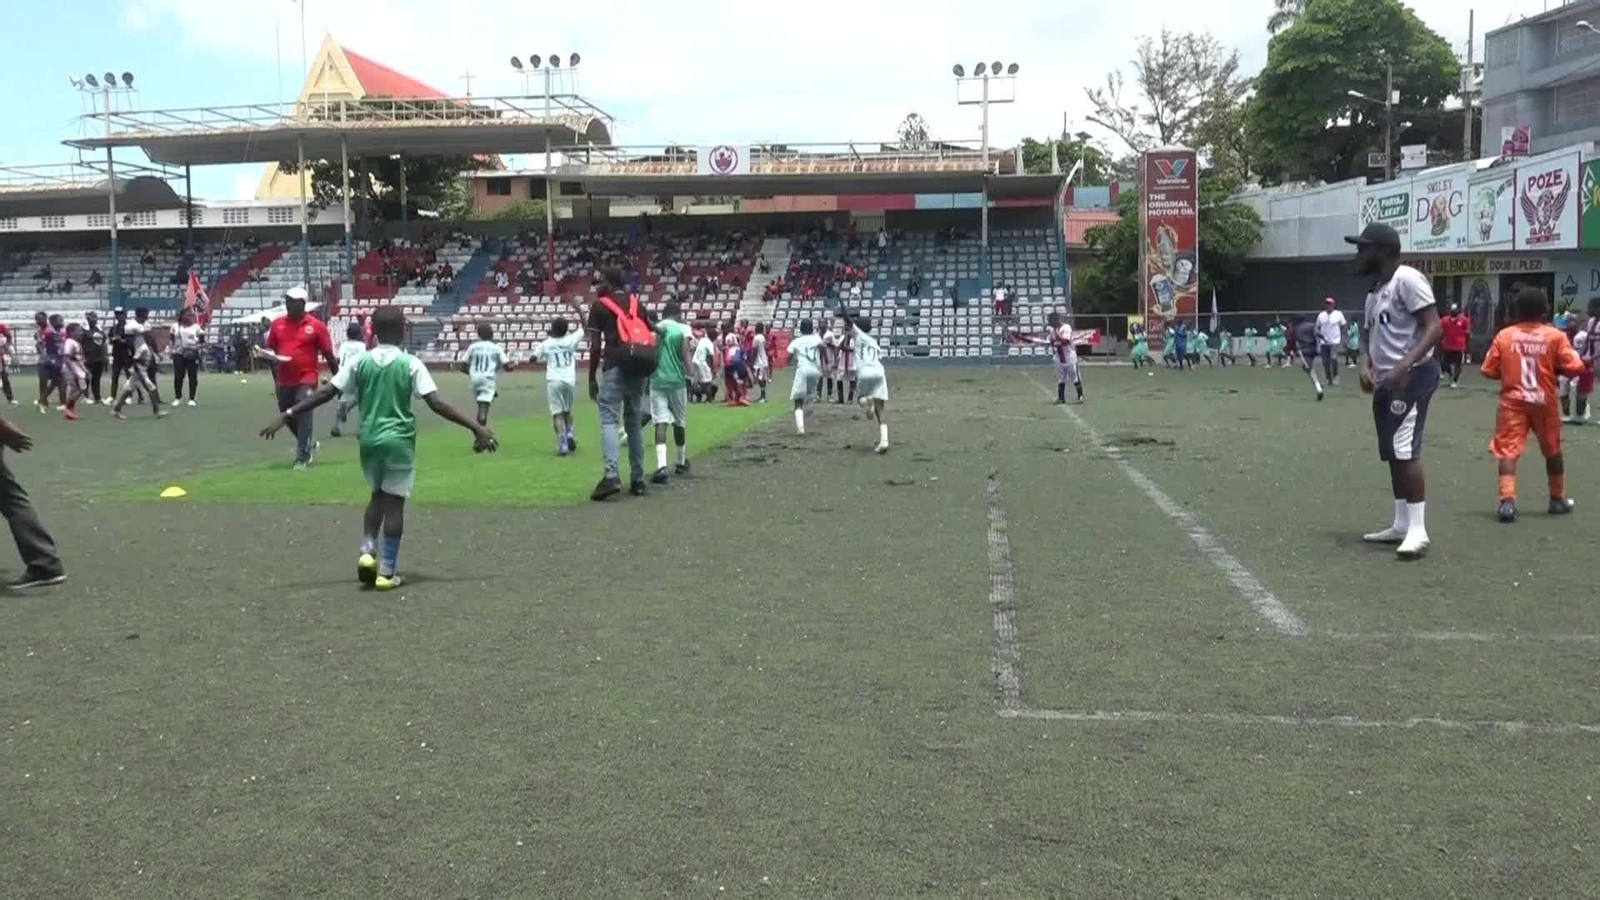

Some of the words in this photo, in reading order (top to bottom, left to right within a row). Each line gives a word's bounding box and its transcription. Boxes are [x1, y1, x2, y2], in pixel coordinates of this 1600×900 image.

[1528, 168, 1563, 192] POZE
[1148, 208, 1179, 216] MOTOR
[1181, 207, 1195, 215] OIL
[1149, 200, 1189, 208] ORIGINAL
[1416, 190, 1463, 222] DG
